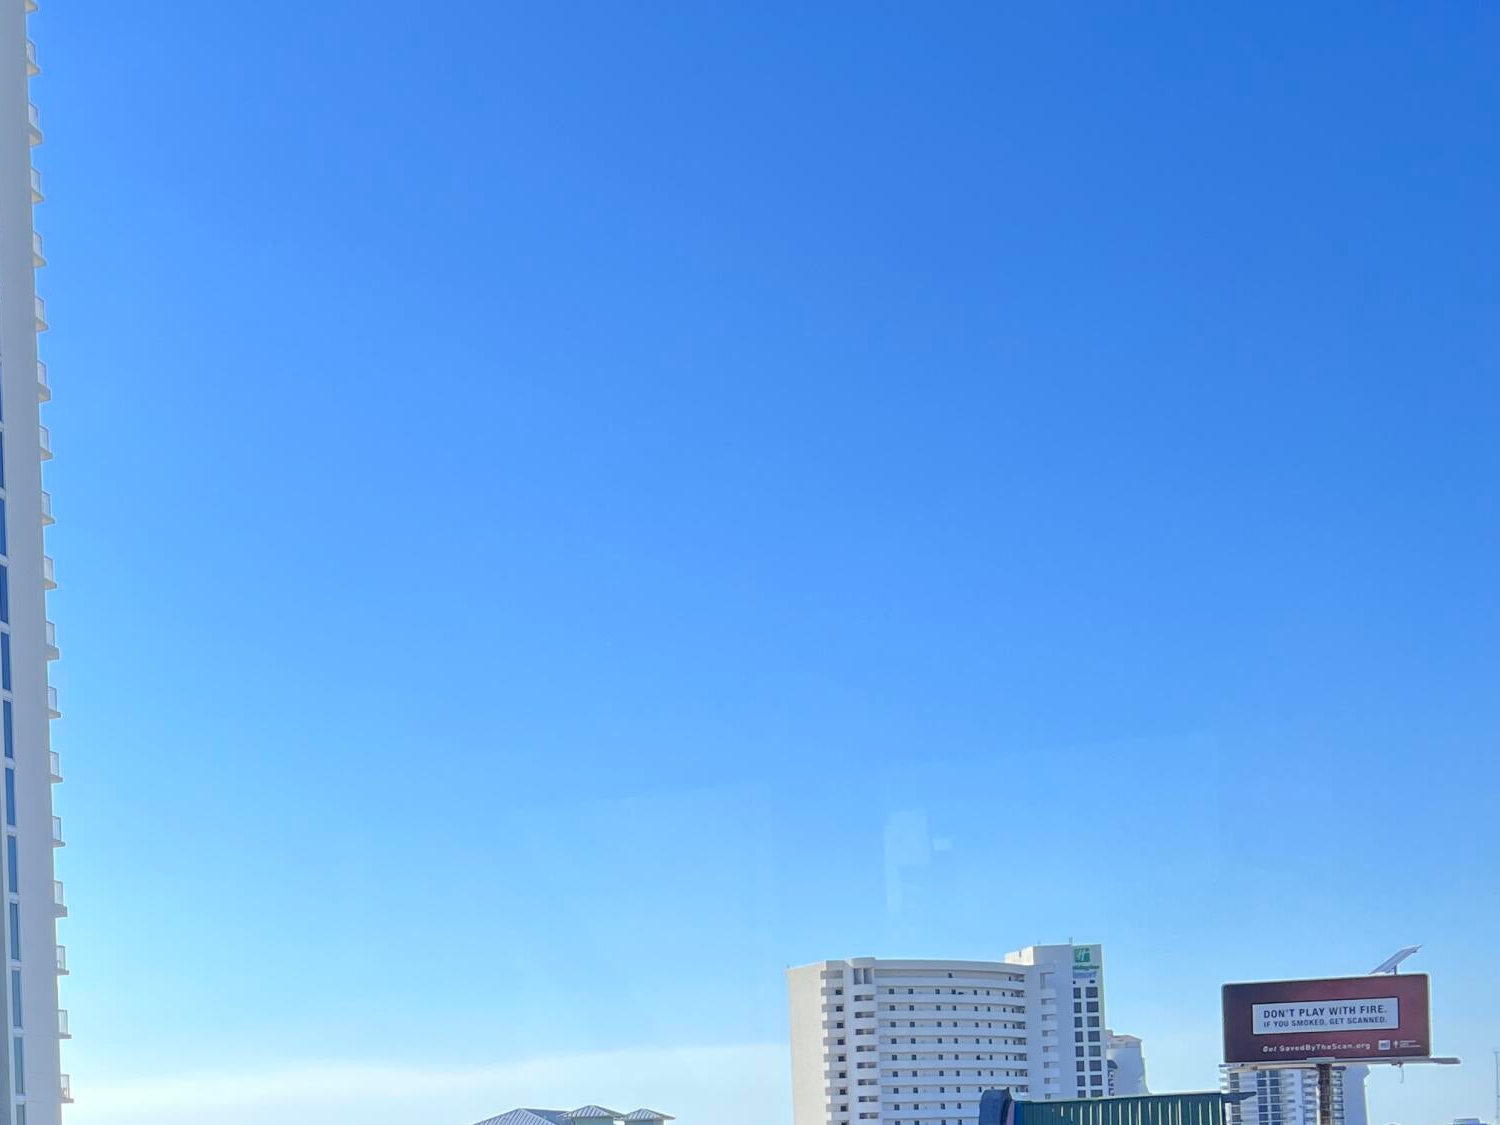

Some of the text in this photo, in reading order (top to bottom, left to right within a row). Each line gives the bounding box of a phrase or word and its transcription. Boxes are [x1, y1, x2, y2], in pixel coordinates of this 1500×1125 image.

[1263, 1004, 1388, 1019] DON'T PLAY WITH FIRE.
[1274, 1020, 1289, 1028] YOU
[1329, 1017, 1344, 1025] GET
[1347, 1016, 1388, 1025] SCANNED.
[1262, 1045, 1277, 1053] Get
[1279, 1042, 1372, 1053] SavedByTheScan.org
